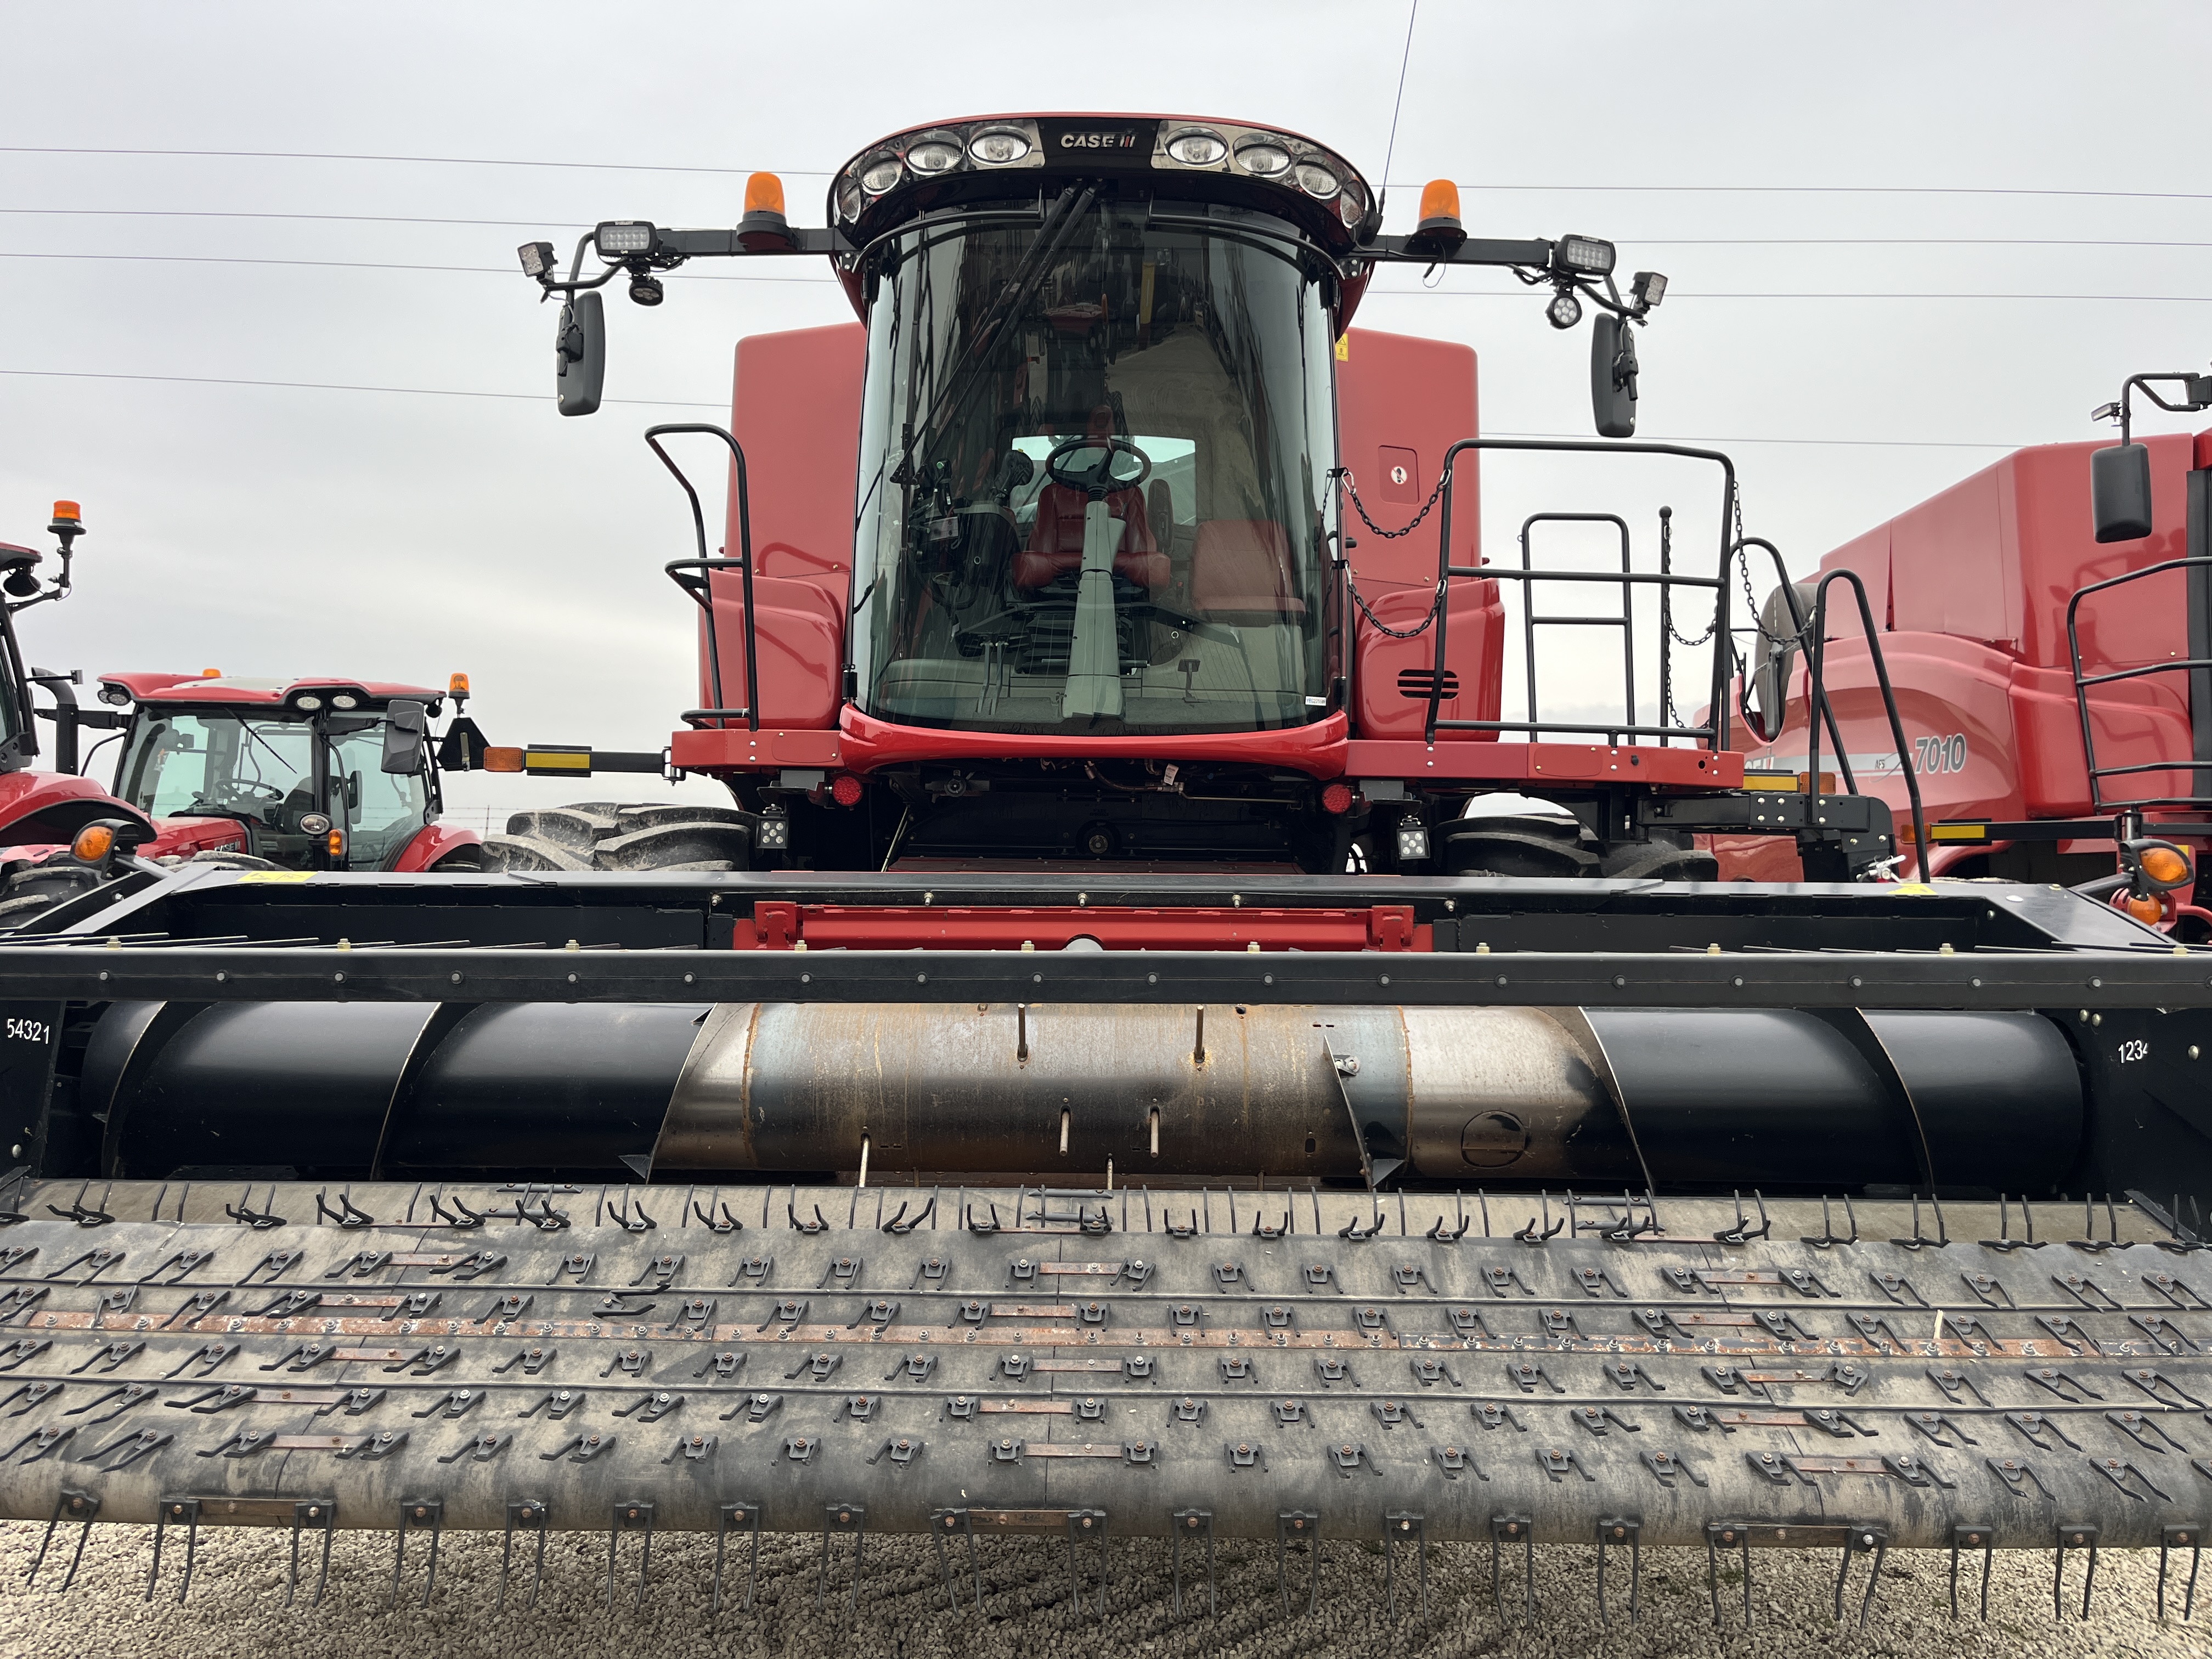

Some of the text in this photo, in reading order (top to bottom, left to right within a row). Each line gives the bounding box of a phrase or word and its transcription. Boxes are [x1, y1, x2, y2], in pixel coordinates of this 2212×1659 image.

[1061, 134, 1114, 148] CASE
[1915, 733, 1966, 775] 7010
[1875, 759, 1885, 770] AFS
[7, 1018, 49, 1045] 54321
